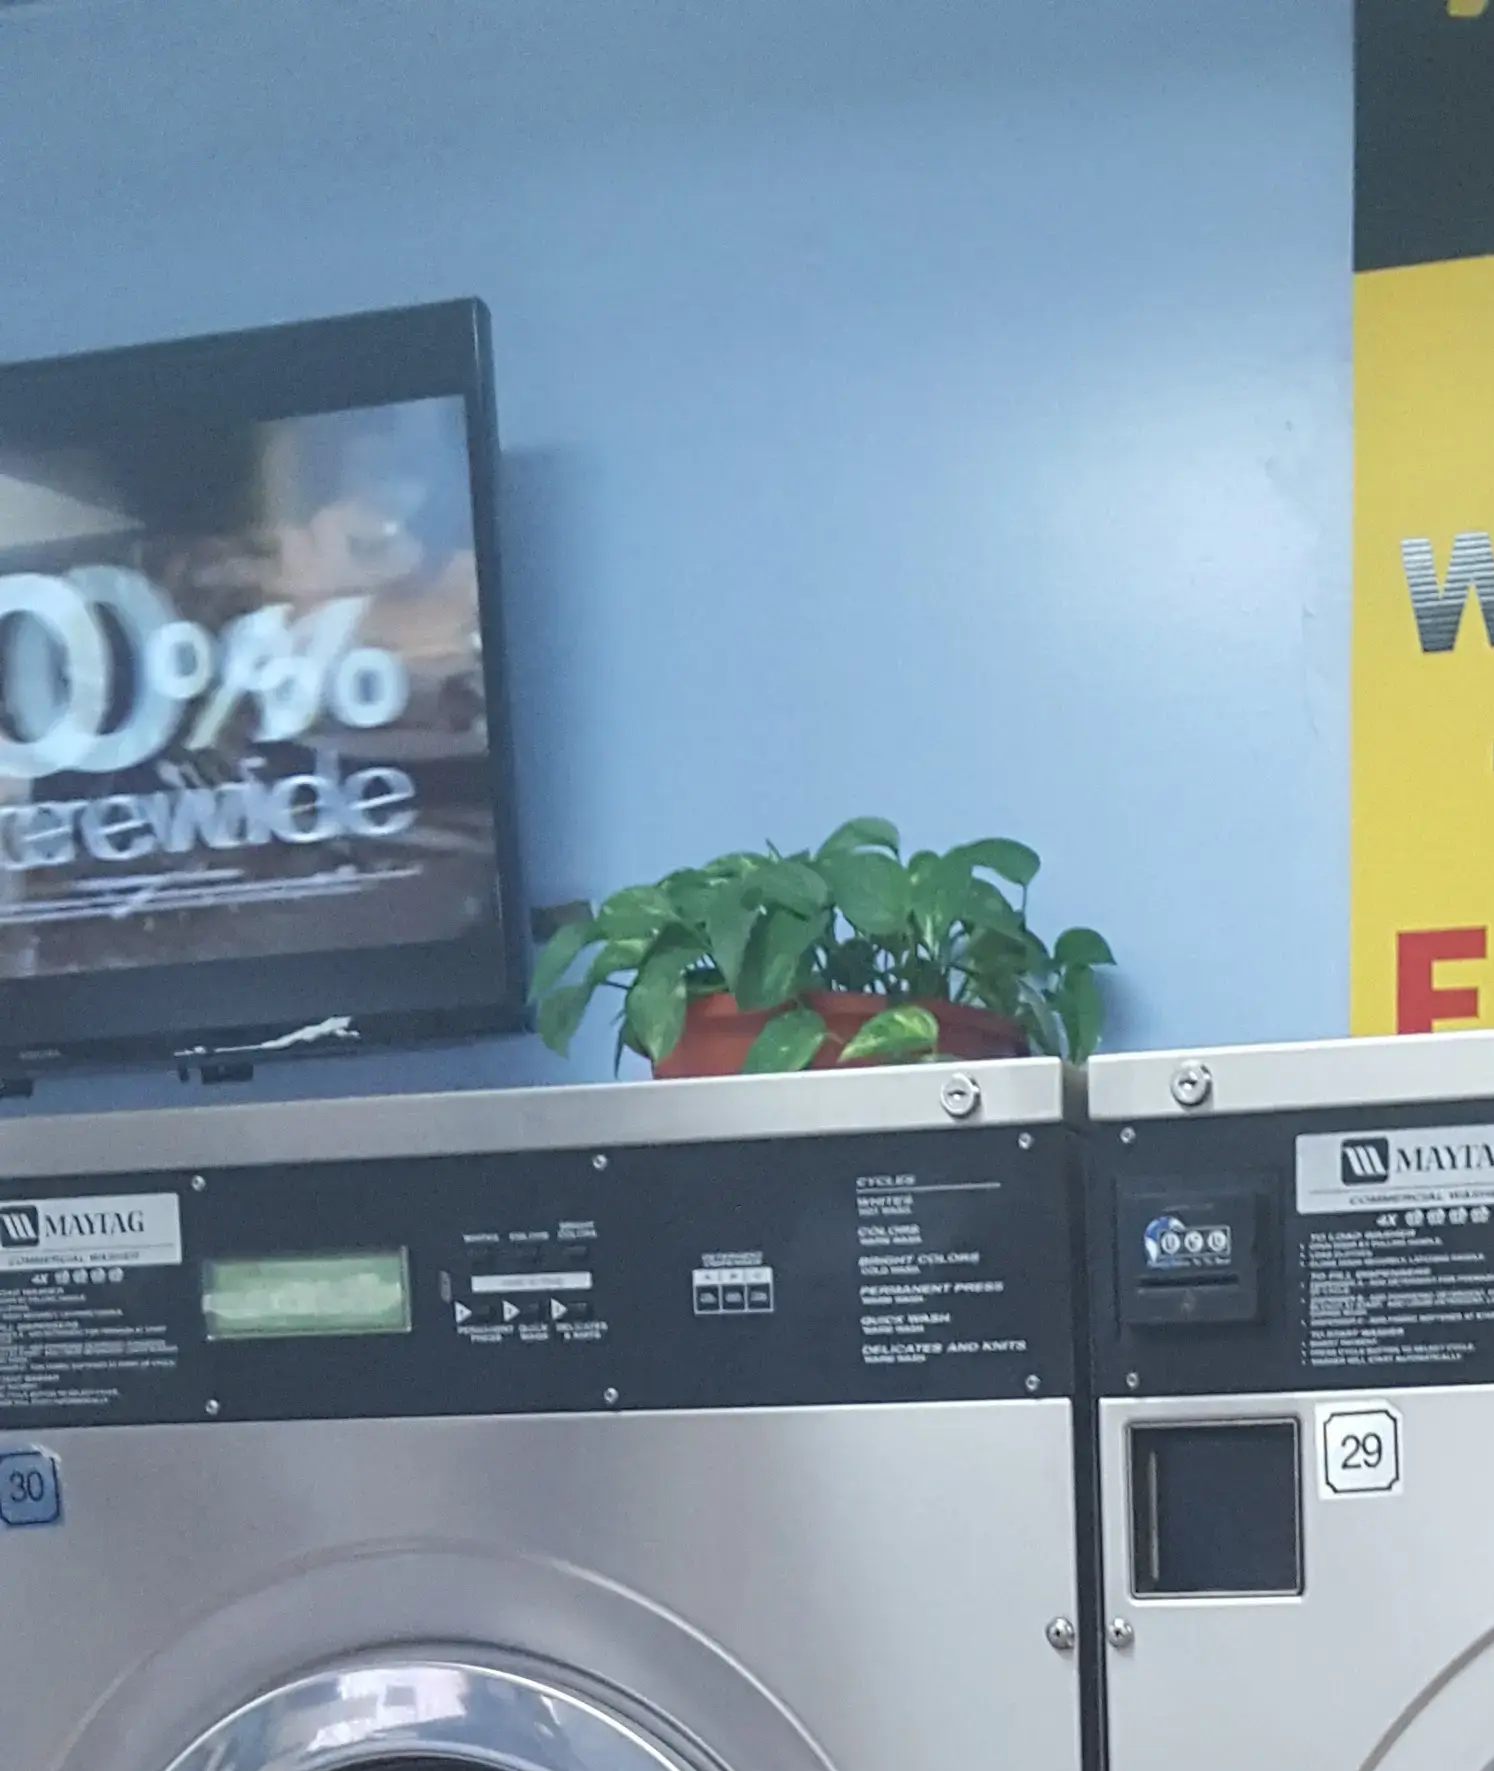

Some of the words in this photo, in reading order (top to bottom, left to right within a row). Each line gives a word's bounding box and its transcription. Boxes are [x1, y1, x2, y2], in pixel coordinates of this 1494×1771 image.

[45, 1211, 144, 1237] MAYTAG
[1341, 1432, 1382, 1469] 29
[9, 1469, 44, 1502] 30
